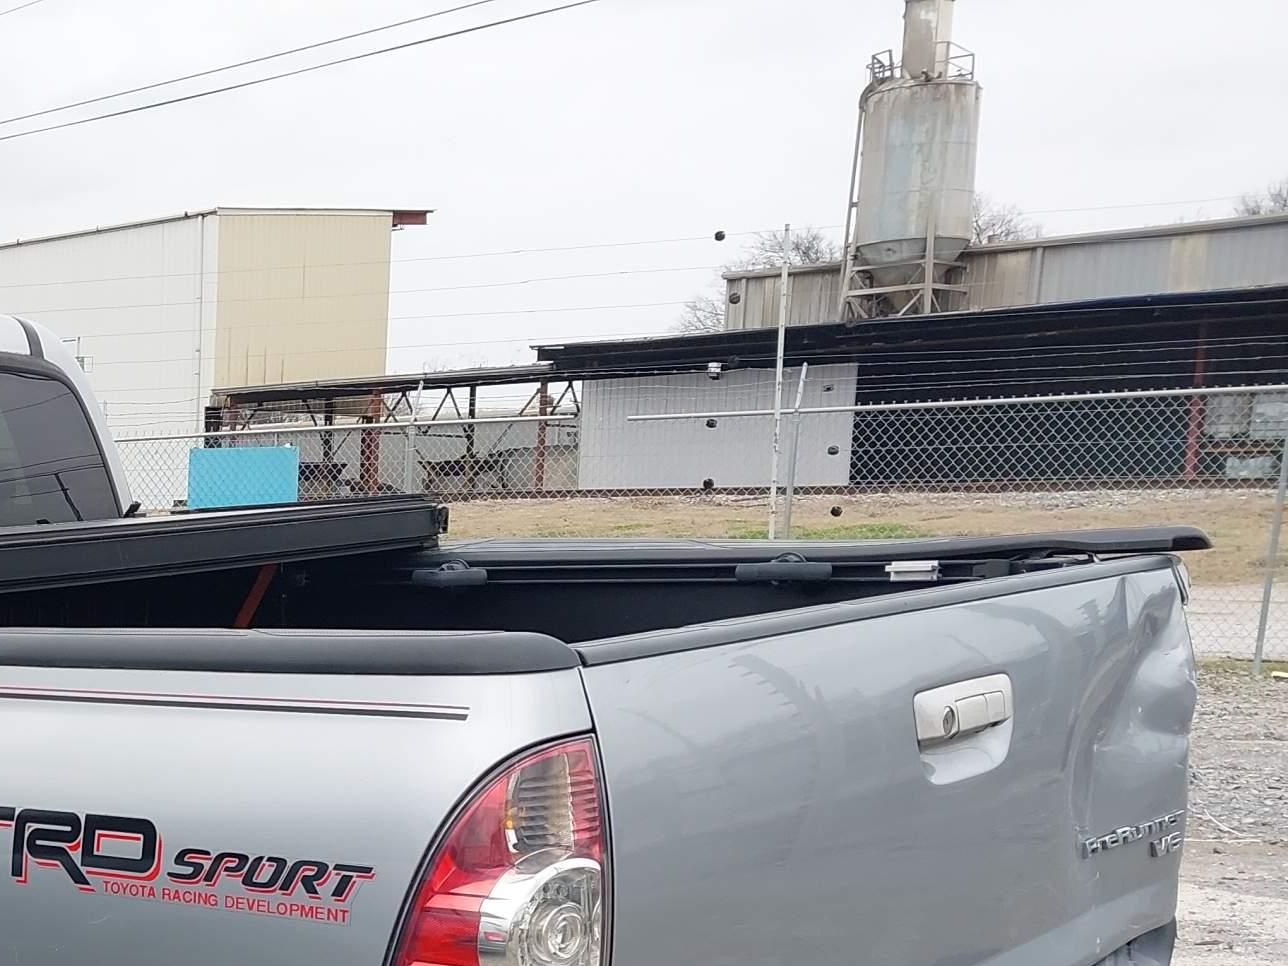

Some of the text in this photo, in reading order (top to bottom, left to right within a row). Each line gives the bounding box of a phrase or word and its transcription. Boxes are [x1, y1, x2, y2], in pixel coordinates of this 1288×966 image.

[166, 847, 376, 903] SPORT
[103, 880, 350, 923] TOYOTA RACING DEVELOPMENT
